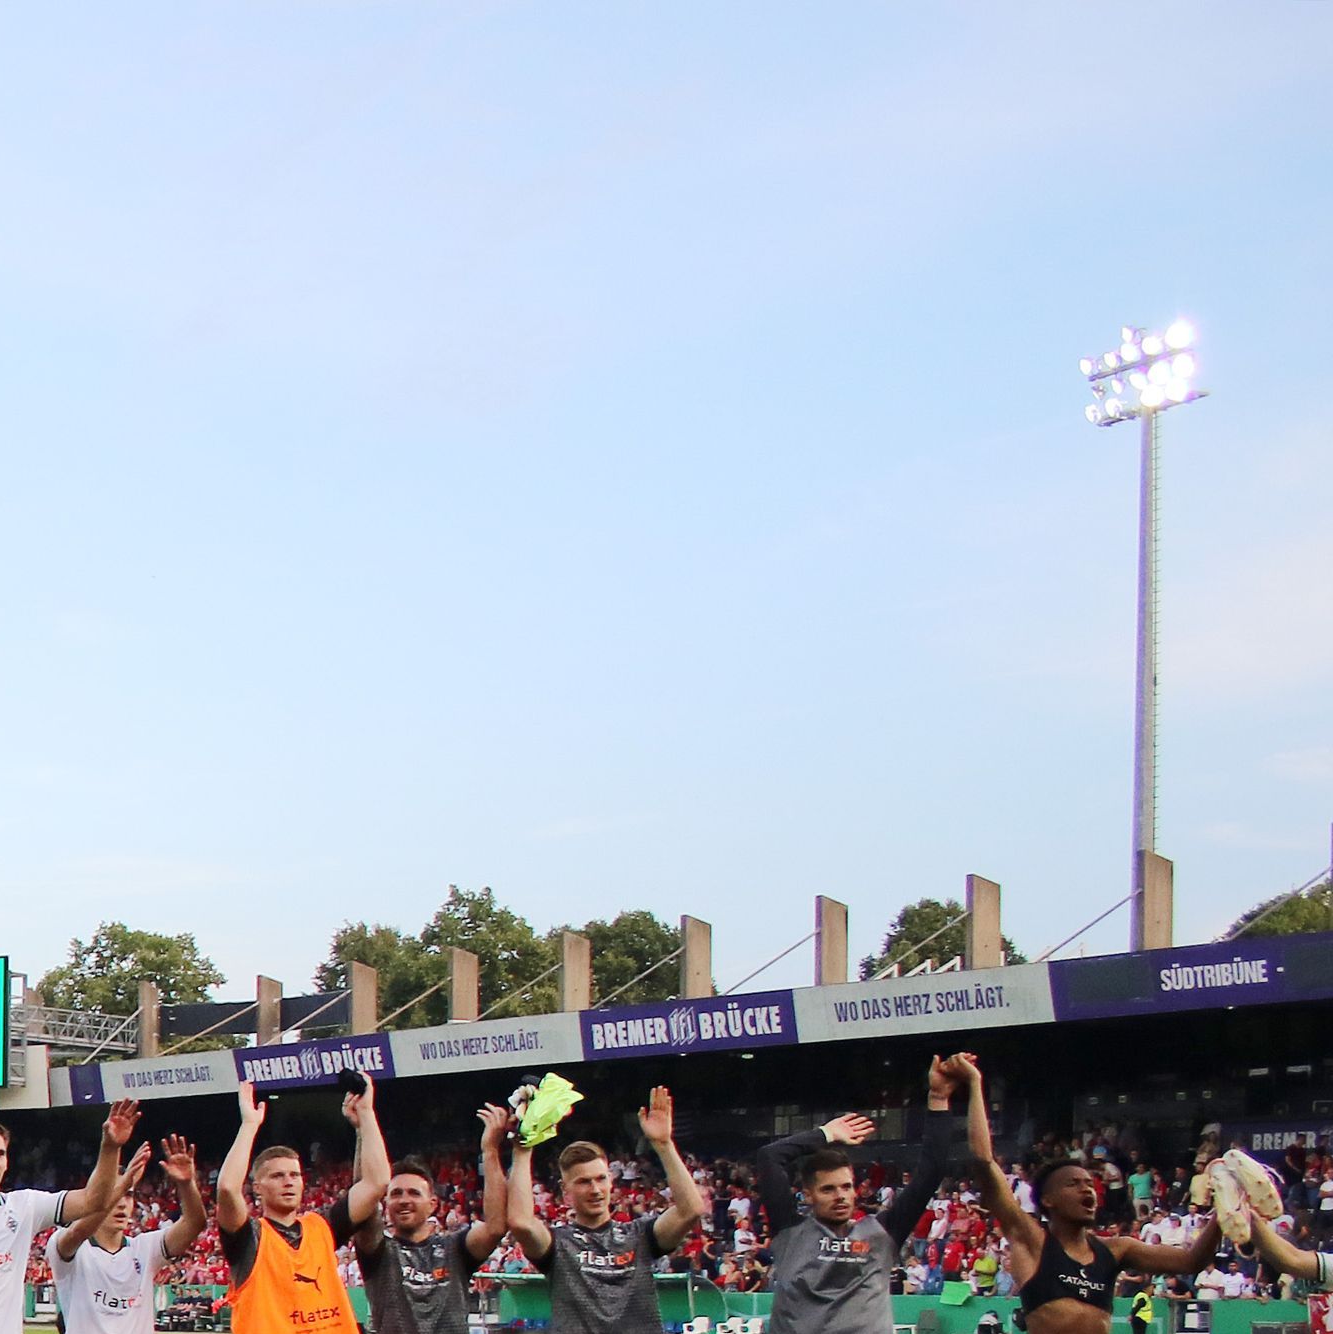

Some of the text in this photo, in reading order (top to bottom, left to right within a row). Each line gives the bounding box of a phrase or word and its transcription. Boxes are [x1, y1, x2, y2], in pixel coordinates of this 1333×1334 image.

[1160, 956, 1269, 992] SÜDTRIBÜNE
[834, 983, 1010, 1023] WO DAS HERZ SCHLÄGT.
[591, 1016, 669, 1050] BREMER
[698, 1002, 783, 1040] BRÜCKE
[243, 1055, 300, 1082] BREMER
[321, 1043, 384, 1074] BRÜCKE
[419, 1029, 543, 1060] WO DAS HERZ SCHLÄGT.
[122, 1073, 137, 1089] WO
[137, 1070, 153, 1087] DAS
[153, 1069, 174, 1086] HERZ
[1058, 1274, 1105, 1292] CATAPULT
